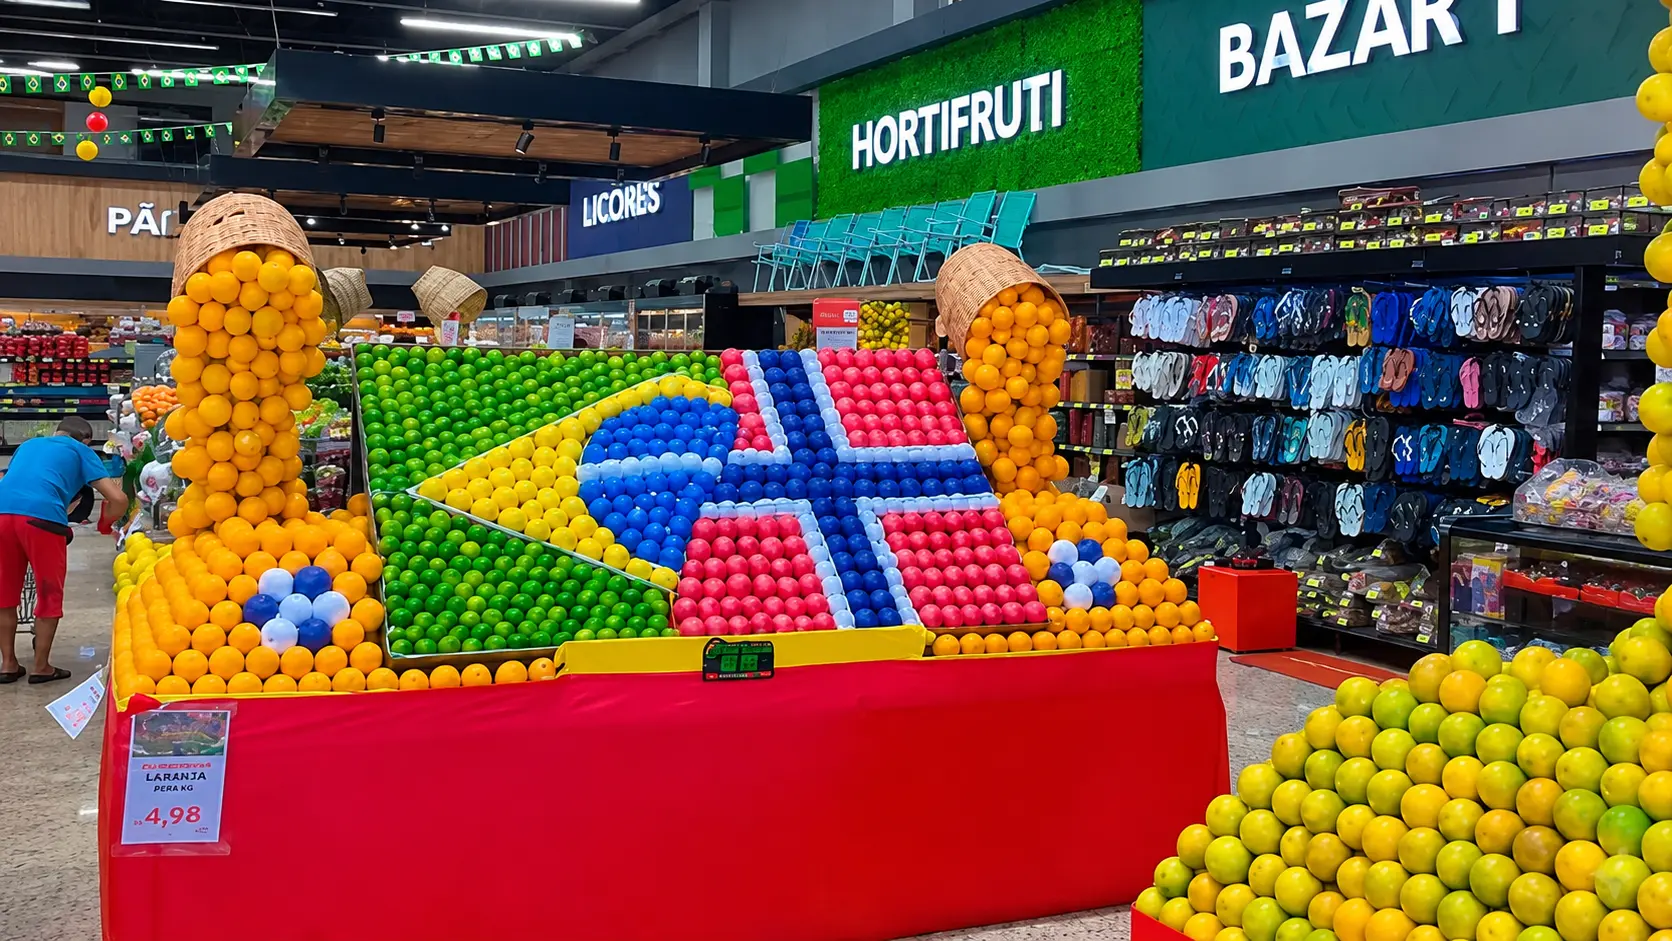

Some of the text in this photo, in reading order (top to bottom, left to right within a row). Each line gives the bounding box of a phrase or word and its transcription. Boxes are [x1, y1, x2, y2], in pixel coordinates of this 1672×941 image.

[1219, 0, 1463, 94] BAZAR
[852, 69, 1062, 170] HORTIFRUTI
[583, 182, 661, 227] LICORES
[145, 772, 207, 782] LARANJA
[180, 784, 194, 792] KG
[144, 805, 201, 829] 4,98
